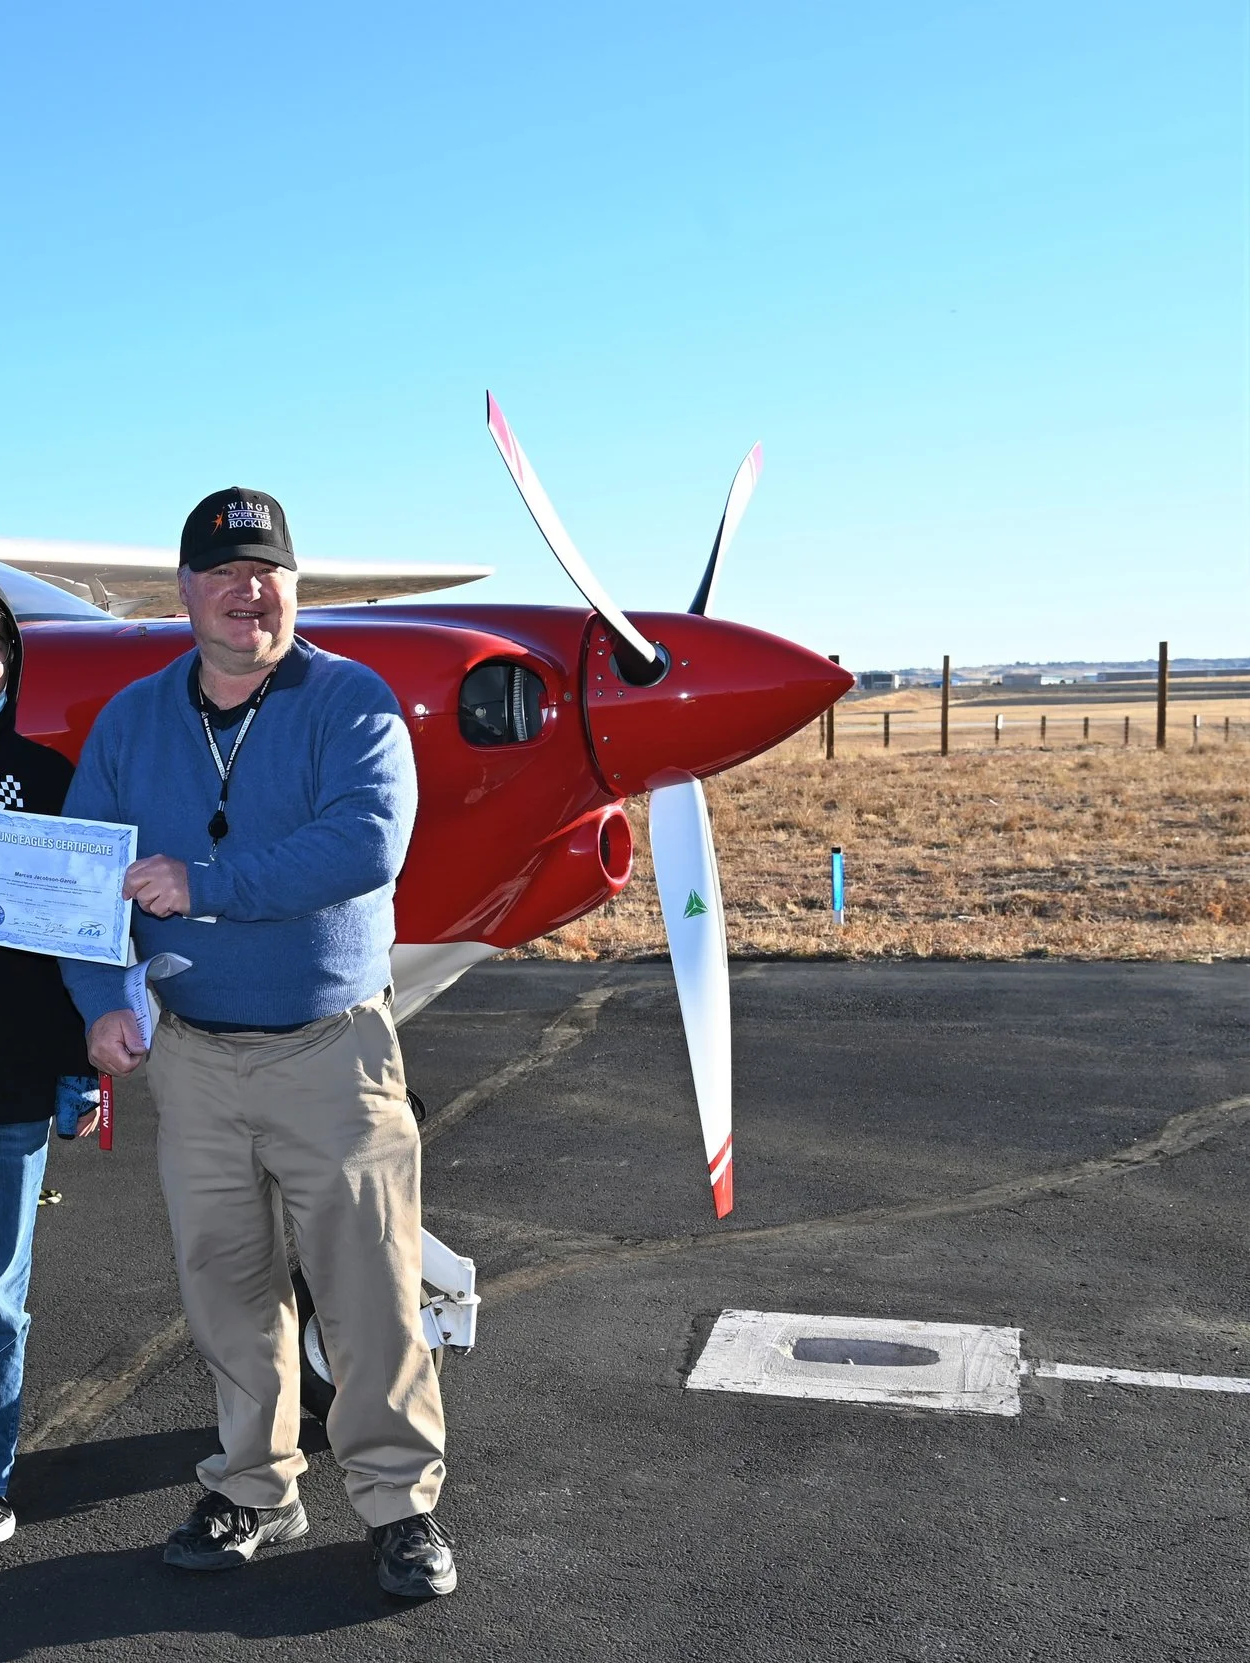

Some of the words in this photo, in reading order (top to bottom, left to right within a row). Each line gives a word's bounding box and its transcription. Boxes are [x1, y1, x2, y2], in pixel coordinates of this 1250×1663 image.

[228, 502, 269, 512] WINGS
[227, 511, 253, 519] OVER
[254, 512, 271, 521] THE
[229, 519, 272, 530] ROCKIES
[18, 834, 54, 849] EAGLES
[55, 839, 113, 856] CERTIFICATE
[14, 871, 33, 879] Marcus
[77, 927, 101, 937] EAA
